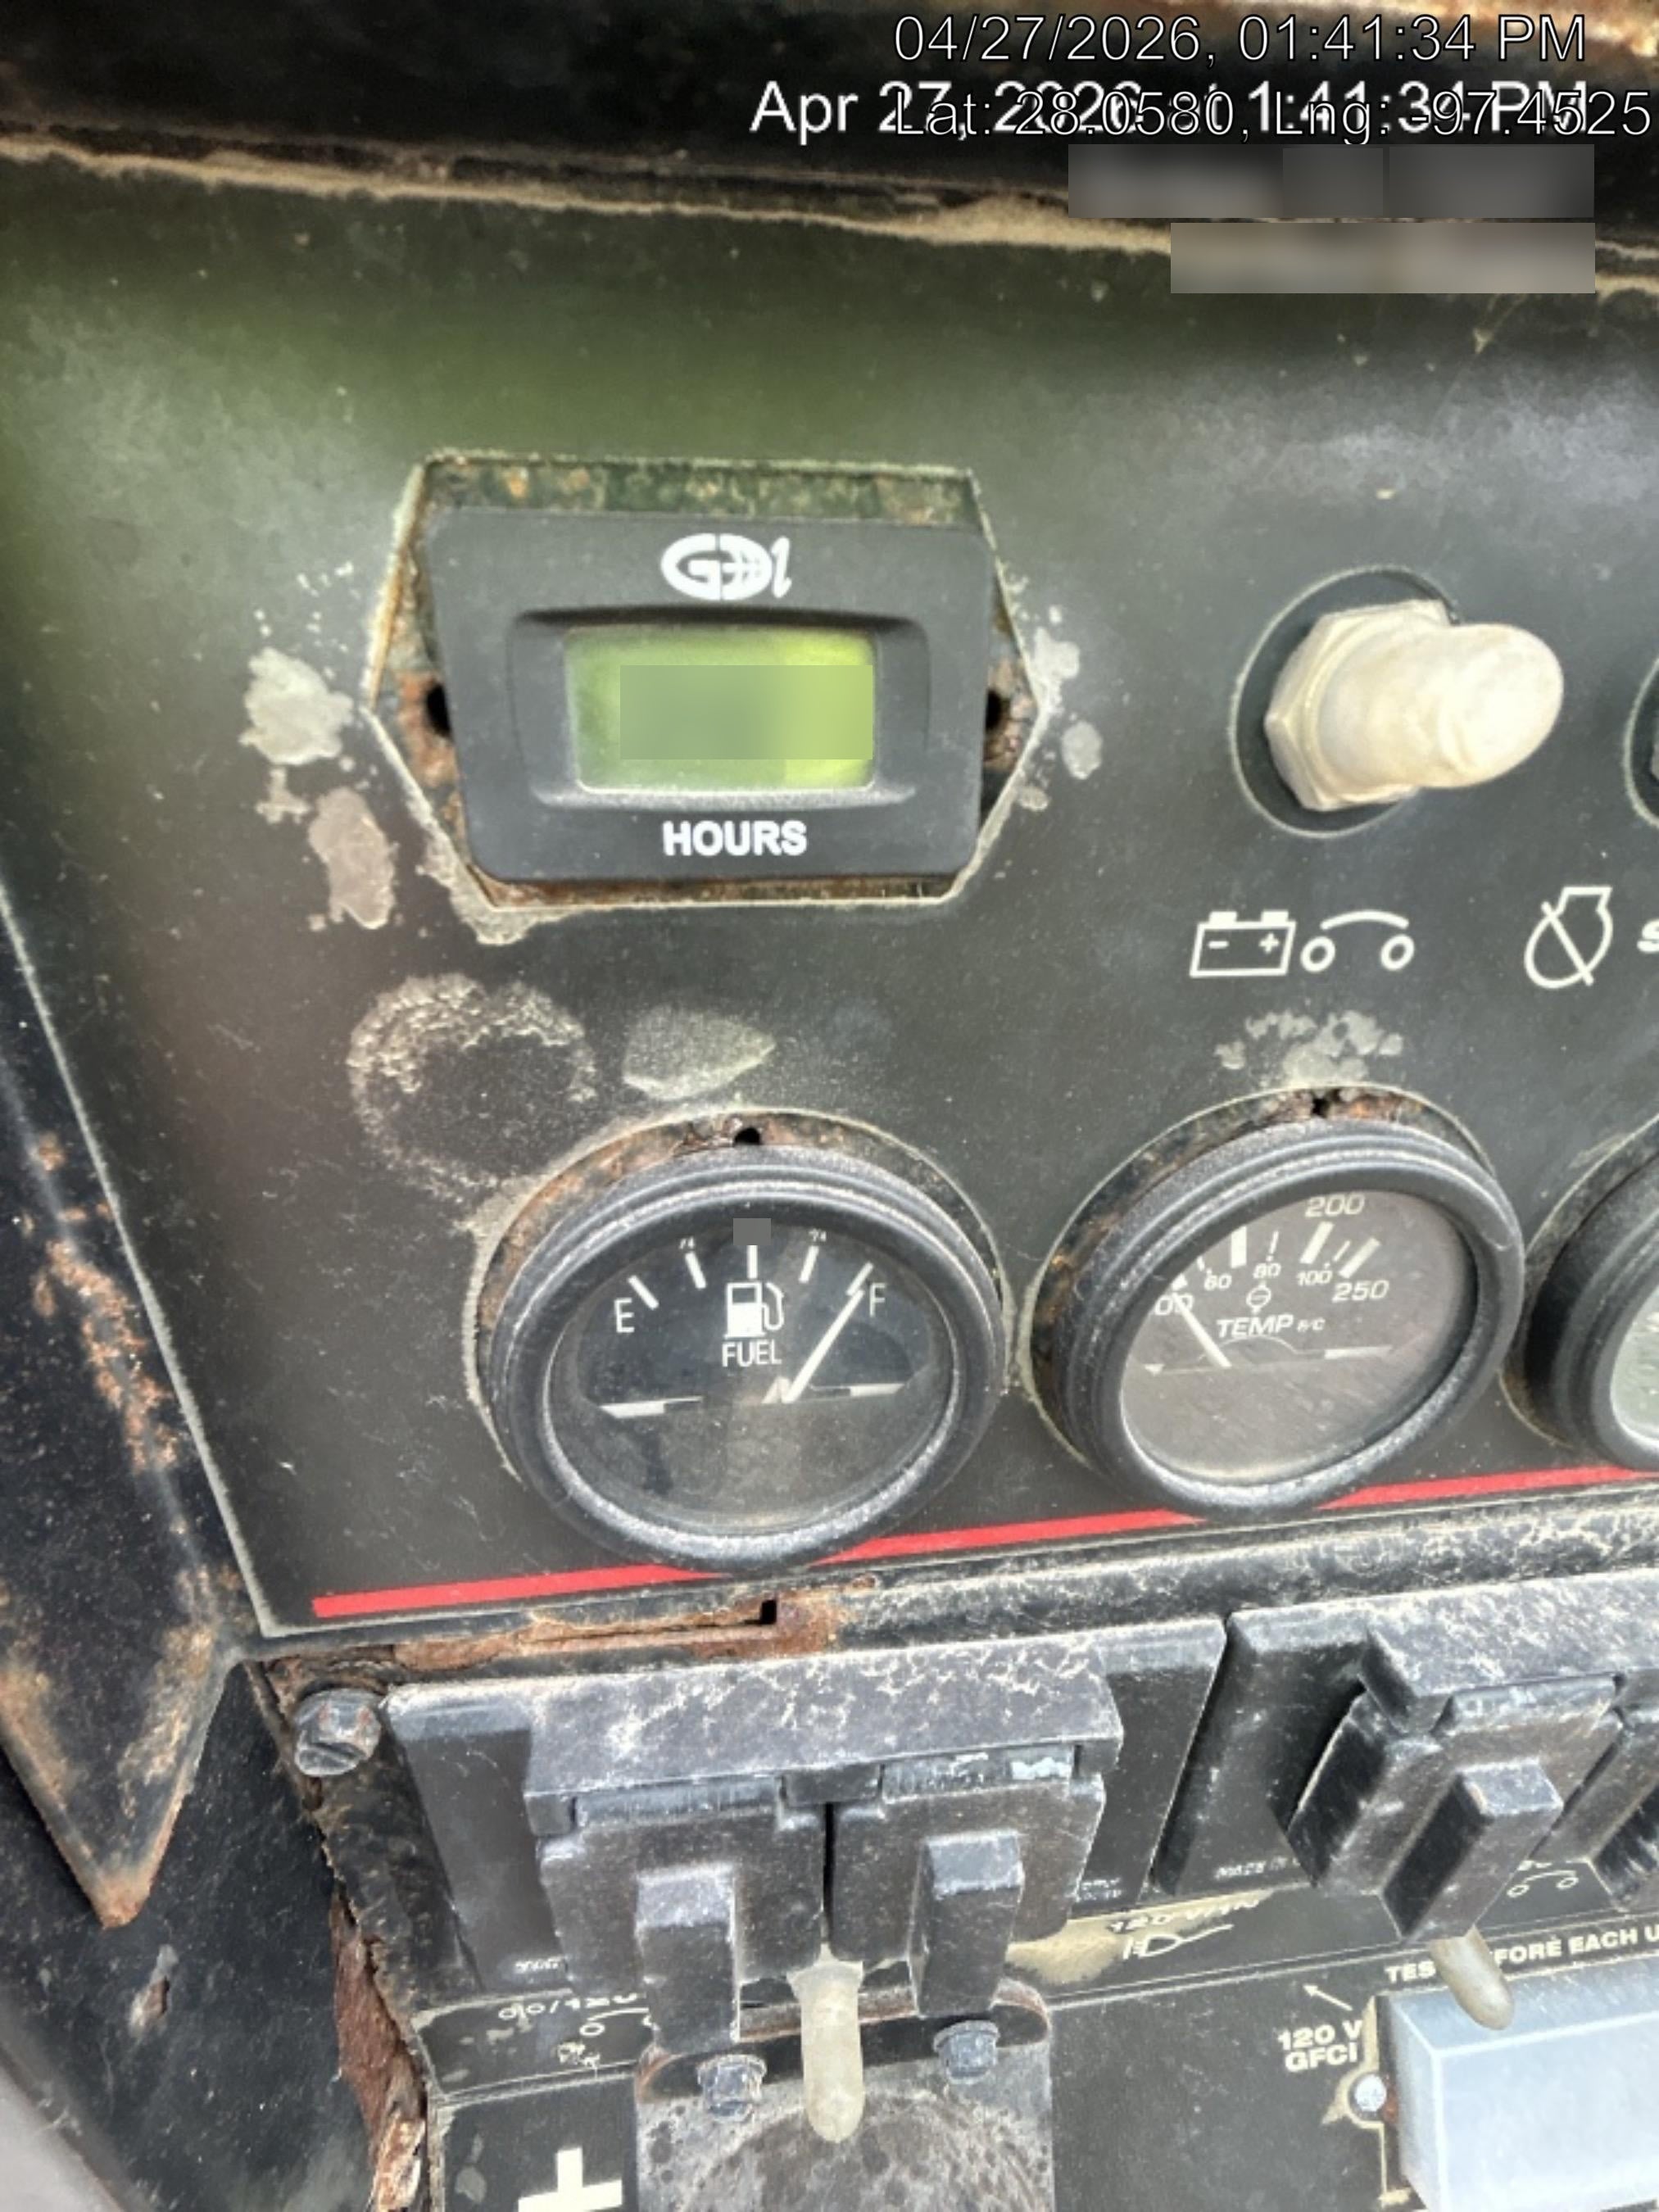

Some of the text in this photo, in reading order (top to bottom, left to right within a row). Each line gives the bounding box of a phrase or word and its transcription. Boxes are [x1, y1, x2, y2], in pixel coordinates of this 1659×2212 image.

[662, 820, 808, 856] HOURS
[1304, 1193, 1367, 1218] 200
[1296, 1269, 1334, 1287] 100
[1331, 1280, 1390, 1304] 250
[614, 1297, 635, 1333] E
[869, 1282, 886, 1317] F
[1216, 1313, 1294, 1339] TEMP
[721, 1339, 782, 1368] FUEL
[1385, 1960, 1436, 1983] TES
[1494, 1938, 1562, 1968] FORE
[1568, 1928, 1638, 1956] EACH
[1276, 2019, 1363, 2051] 120 V
[1284, 2042, 1359, 2073] GFCI
